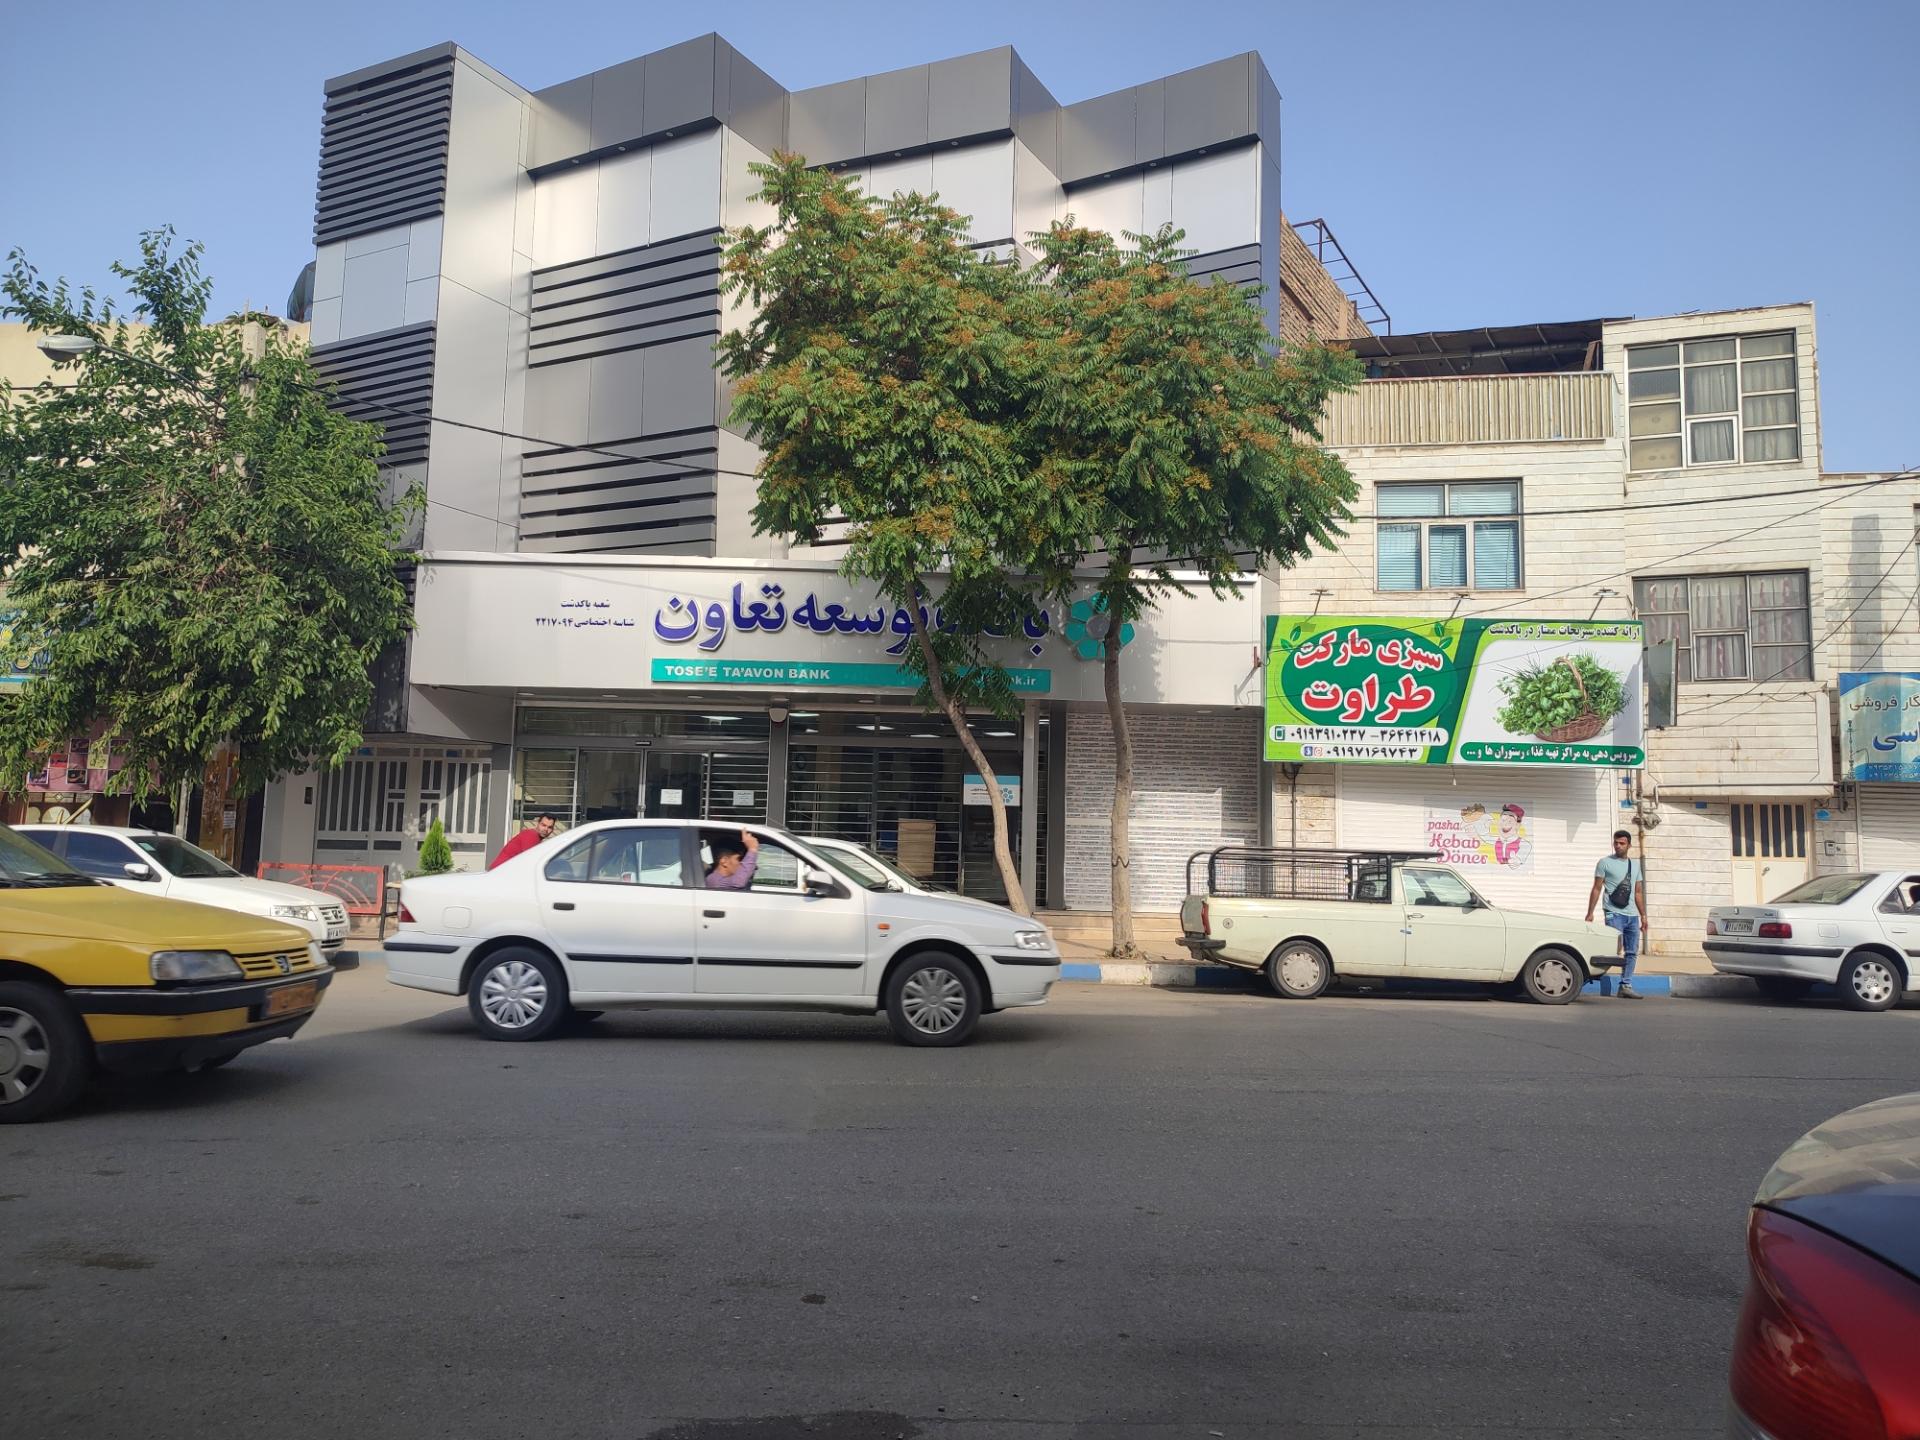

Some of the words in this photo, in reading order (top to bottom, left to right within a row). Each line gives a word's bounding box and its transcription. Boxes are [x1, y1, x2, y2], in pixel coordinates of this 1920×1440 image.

[653, 581, 787, 651] تعاون
[1489, 624, 1521, 637] پاکدشت
[1524, 626, 1534, 637] در
[1535, 626, 1556, 639] ممتاز
[1597, 625, 1619, 636] کننده
[1622, 625, 1640, 640] ارائه
[1294, 629, 1372, 667] مارکت
[1377, 640, 1443, 671] سبزی
[664, 665, 717, 677] TOSE'E
[723, 666, 784, 679] TA'AVON
[788, 668, 831, 680] BANK
[1302, 674, 1435, 723] طراوت
[1850, 695, 1898, 711] فروشی
[1495, 747, 1525, 759] رستوران
[1545, 748, 1559, 759] تهیه
[1560, 746, 1581, 761] مراکز
[1582, 750, 1590, 760] به
[1591, 750, 1608, 761] دهی
[1610, 751, 1638, 762] سرویس
[1427, 819, 1460, 831] pasha
[1429, 833, 1481, 848] Kebab
[1436, 848, 1488, 864] Döner
